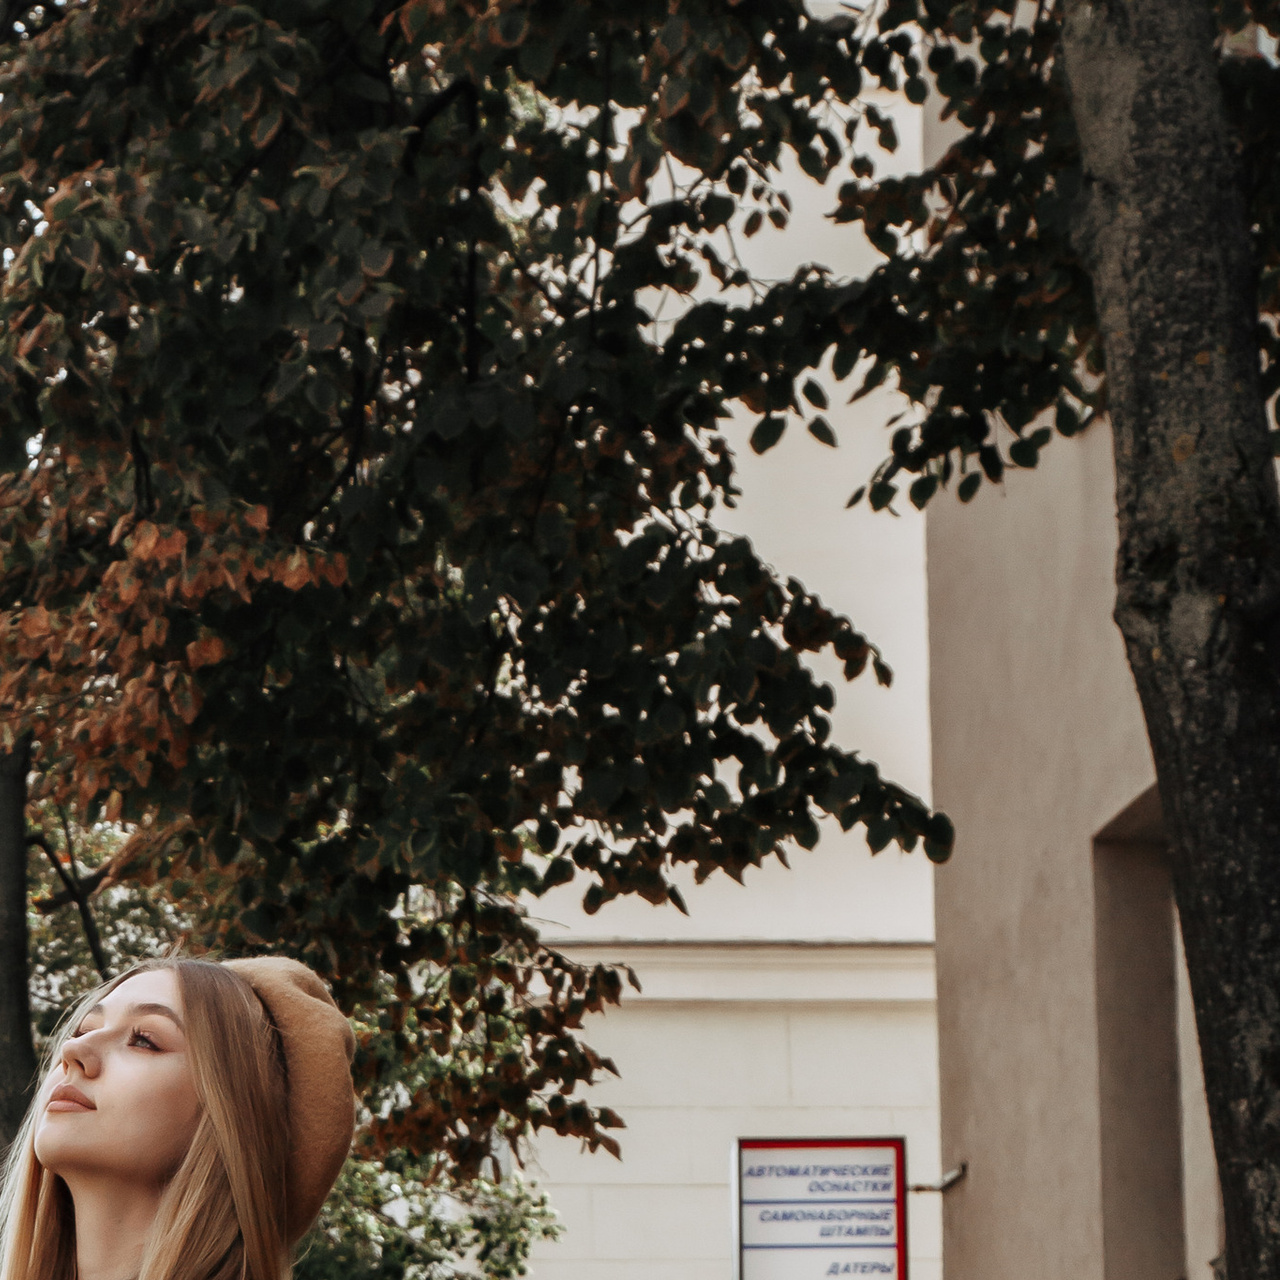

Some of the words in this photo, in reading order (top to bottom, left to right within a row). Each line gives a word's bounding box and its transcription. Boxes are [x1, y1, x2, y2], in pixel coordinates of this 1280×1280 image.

[808, 1180, 893, 1193] ОСНАСТКИ
[759, 1209, 893, 1222] САМОНАБОРНЫЕ
[820, 1225, 894, 1237] ШТАМПЫ
[826, 1262, 895, 1275] ДАТЕРЫ
